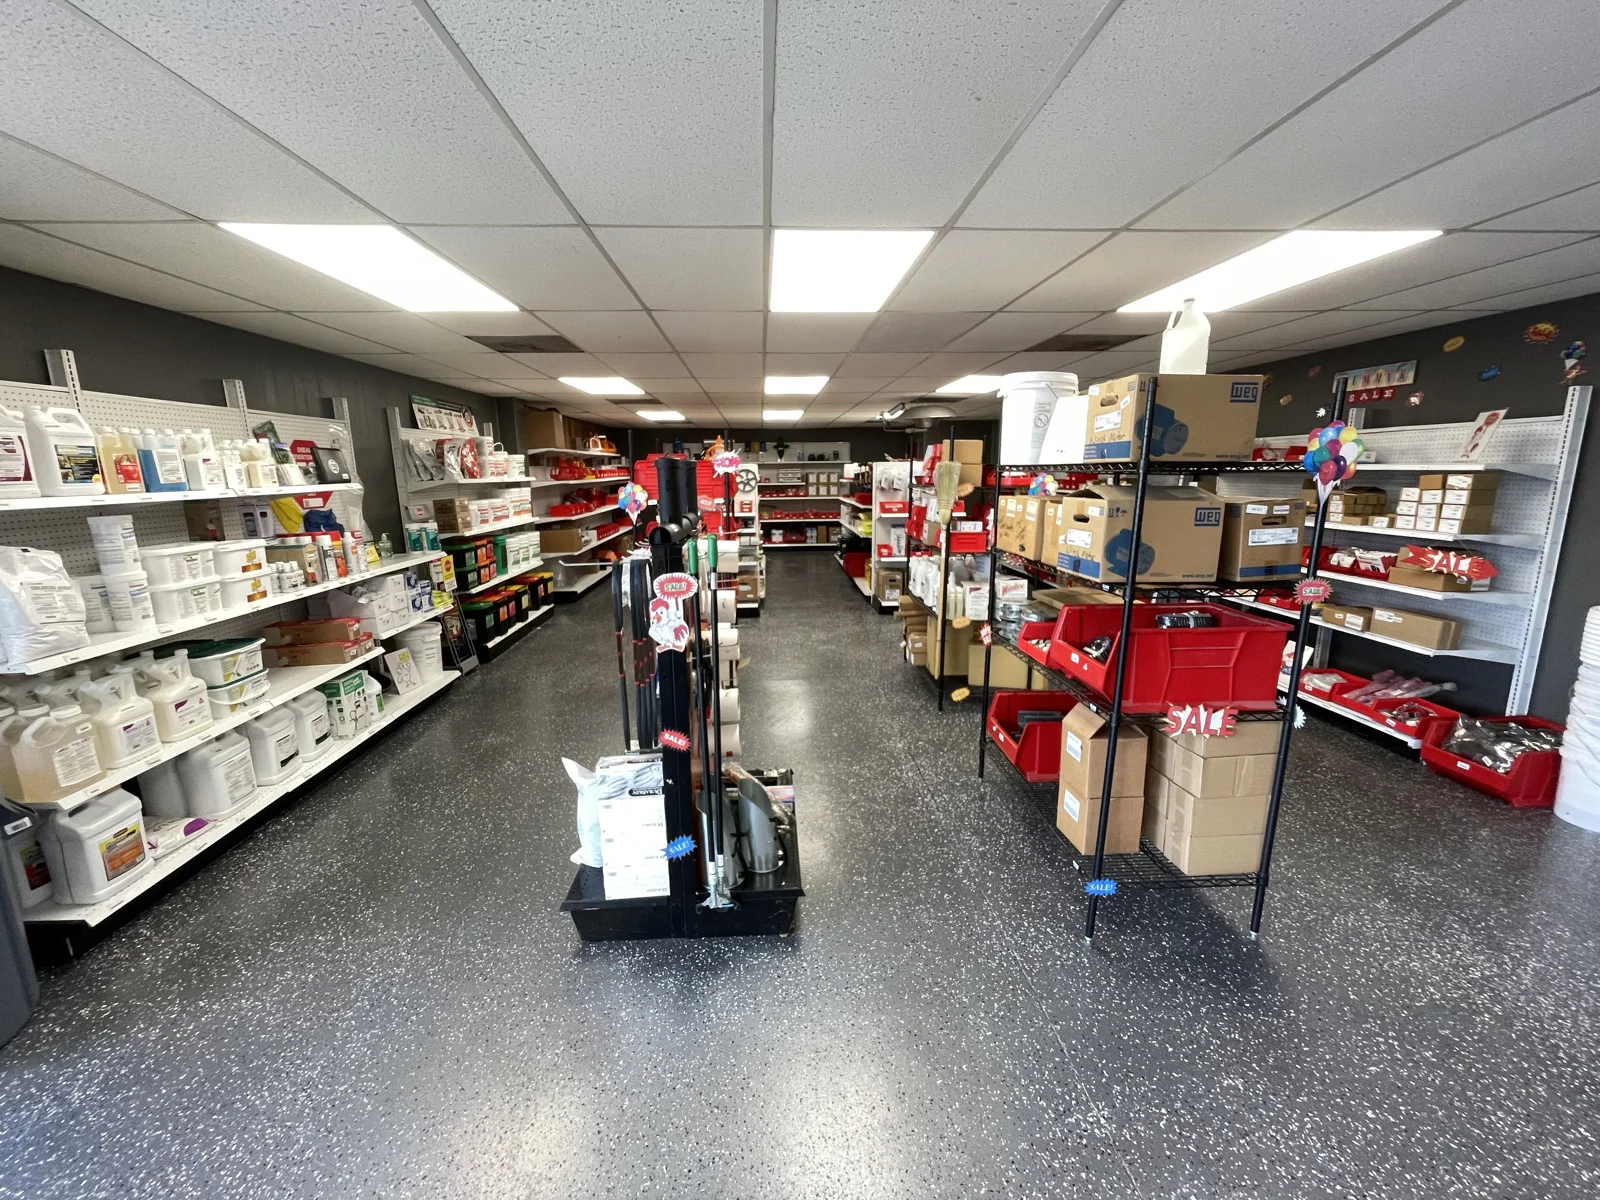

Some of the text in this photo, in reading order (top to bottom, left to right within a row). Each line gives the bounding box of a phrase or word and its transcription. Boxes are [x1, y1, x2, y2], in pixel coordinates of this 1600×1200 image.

[1347, 367, 1408, 387] UMMER
[1348, 389, 1394, 402] SALE
[1421, 548, 1485, 580] SALE
[1165, 705, 1239, 737] SALE
[663, 733, 686, 747] SALE!
[669, 840, 690, 855] SALE!
